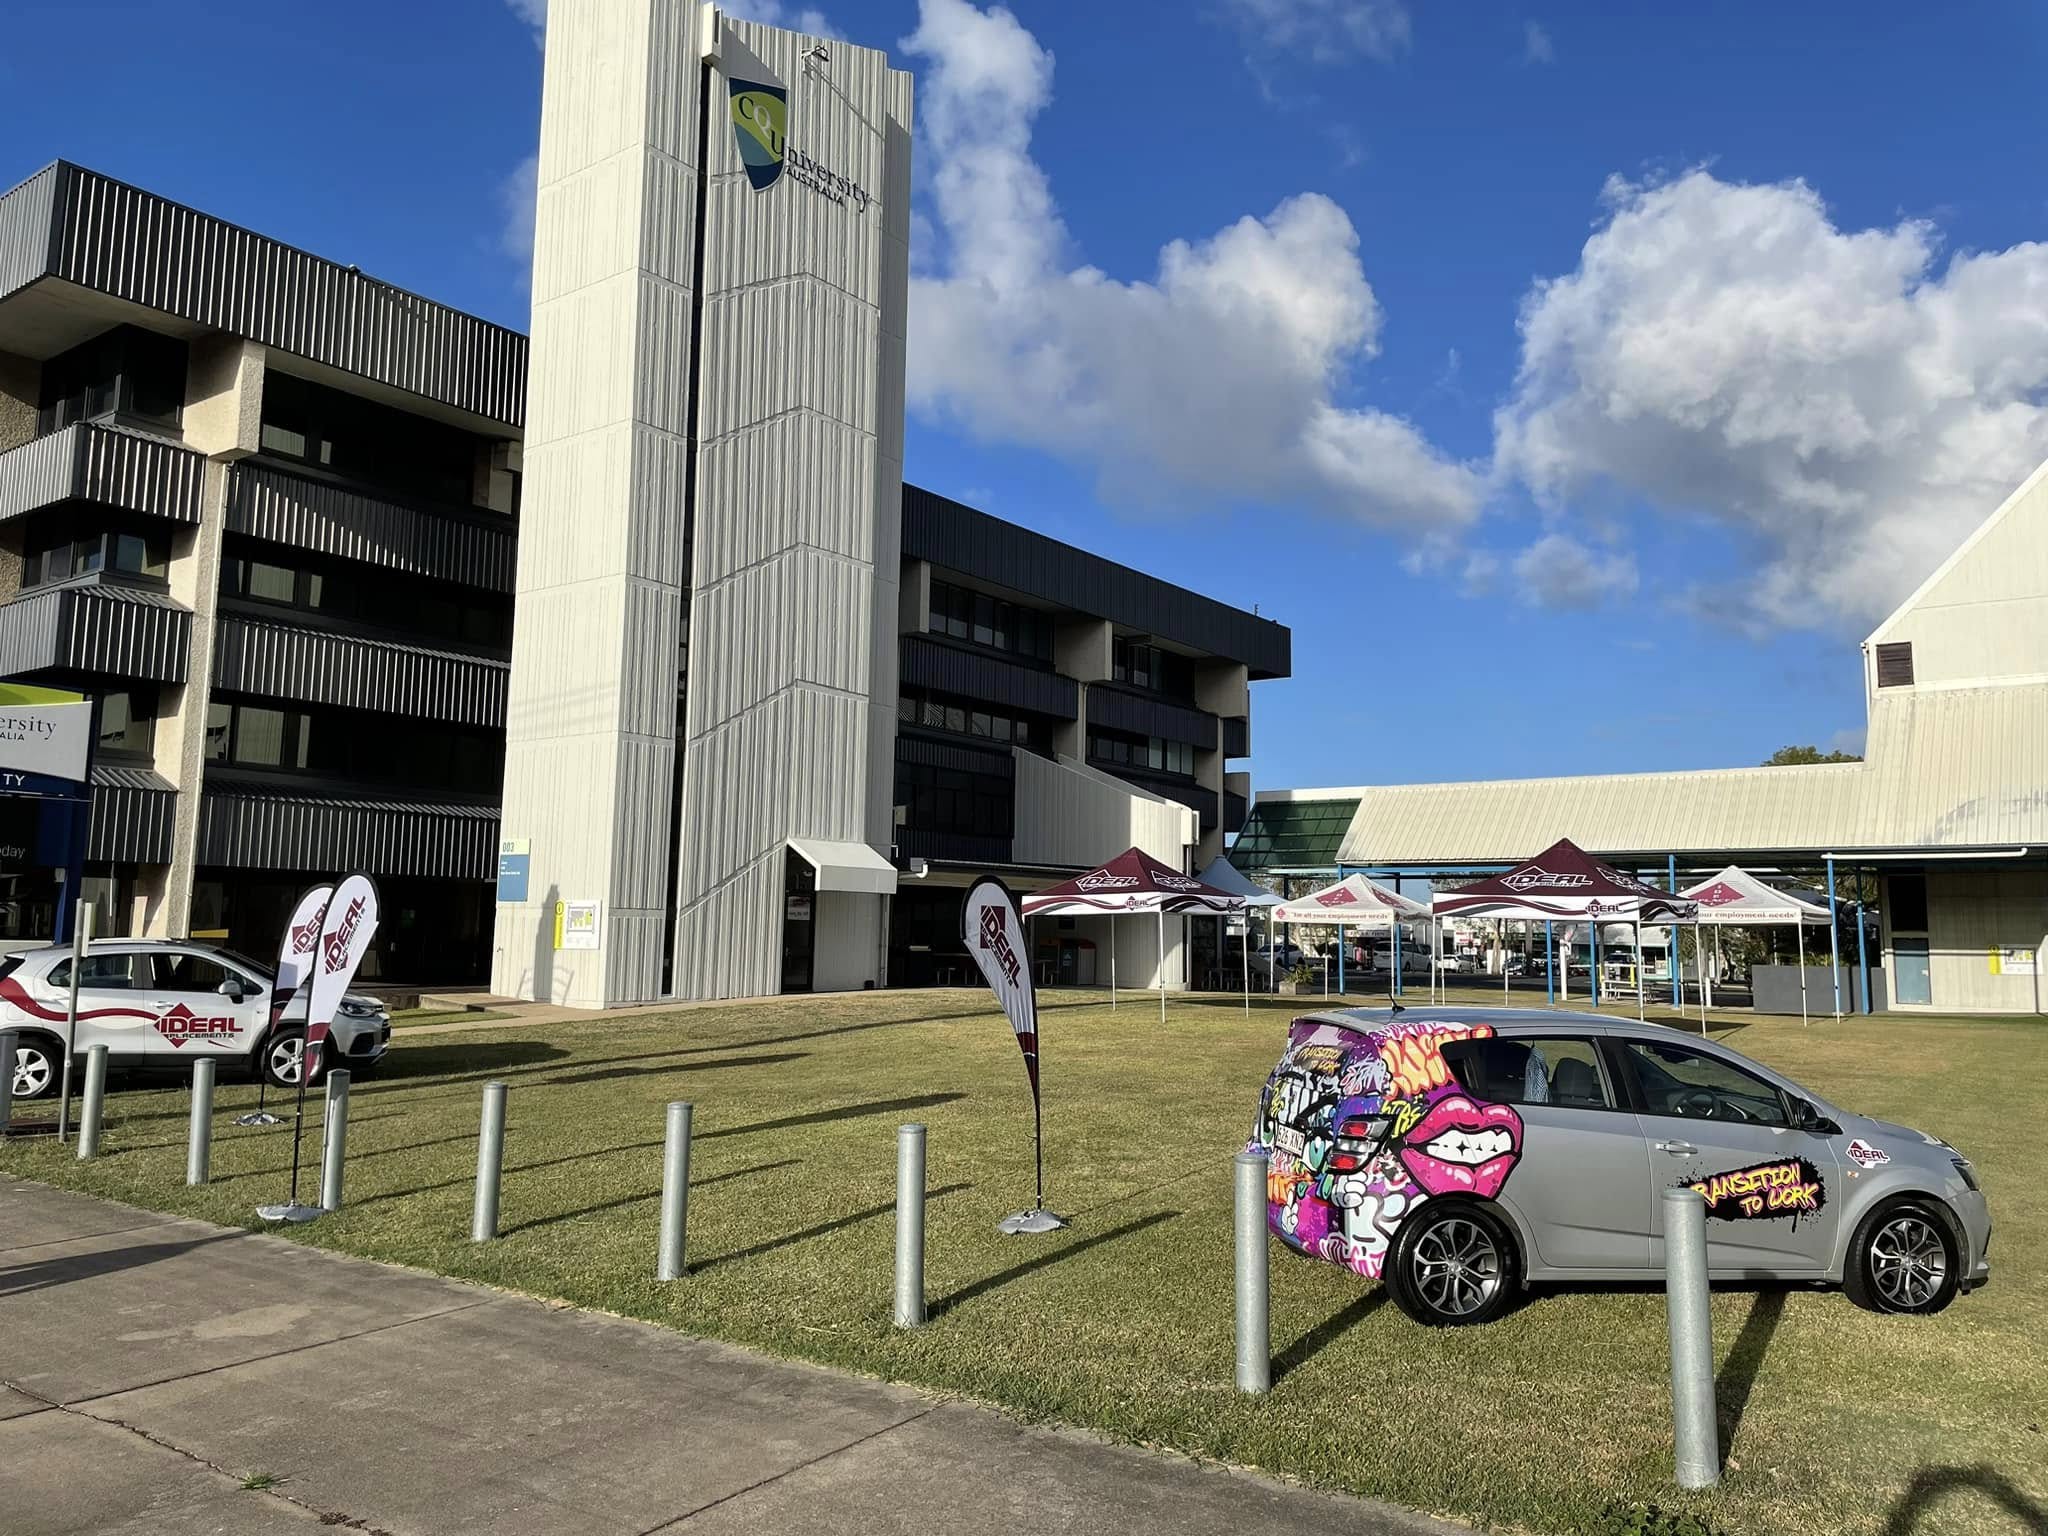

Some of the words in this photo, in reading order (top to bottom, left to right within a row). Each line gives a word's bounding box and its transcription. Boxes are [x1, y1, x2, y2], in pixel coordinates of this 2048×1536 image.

[786, 165, 844, 207] AUSTRALIA
[0, 844, 26, 859] day
[1079, 876, 1140, 886] IDEAL
[1507, 874, 1594, 885] IDEAL
[1127, 900, 1150, 908] IDEAL
[1588, 904, 1623, 912] IDEAL
[1714, 911, 1766, 919] employment
[292, 902, 328, 954] IDEA
[325, 896, 367, 974] IDEAL
[980, 905, 1021, 989] IDEAL
[160, 1018, 243, 1033] IDEAL
[1849, 1149, 1888, 1160] IDEAL
[1739, 1195, 1763, 1217] TO
[1767, 1182, 1819, 1210] WORK
